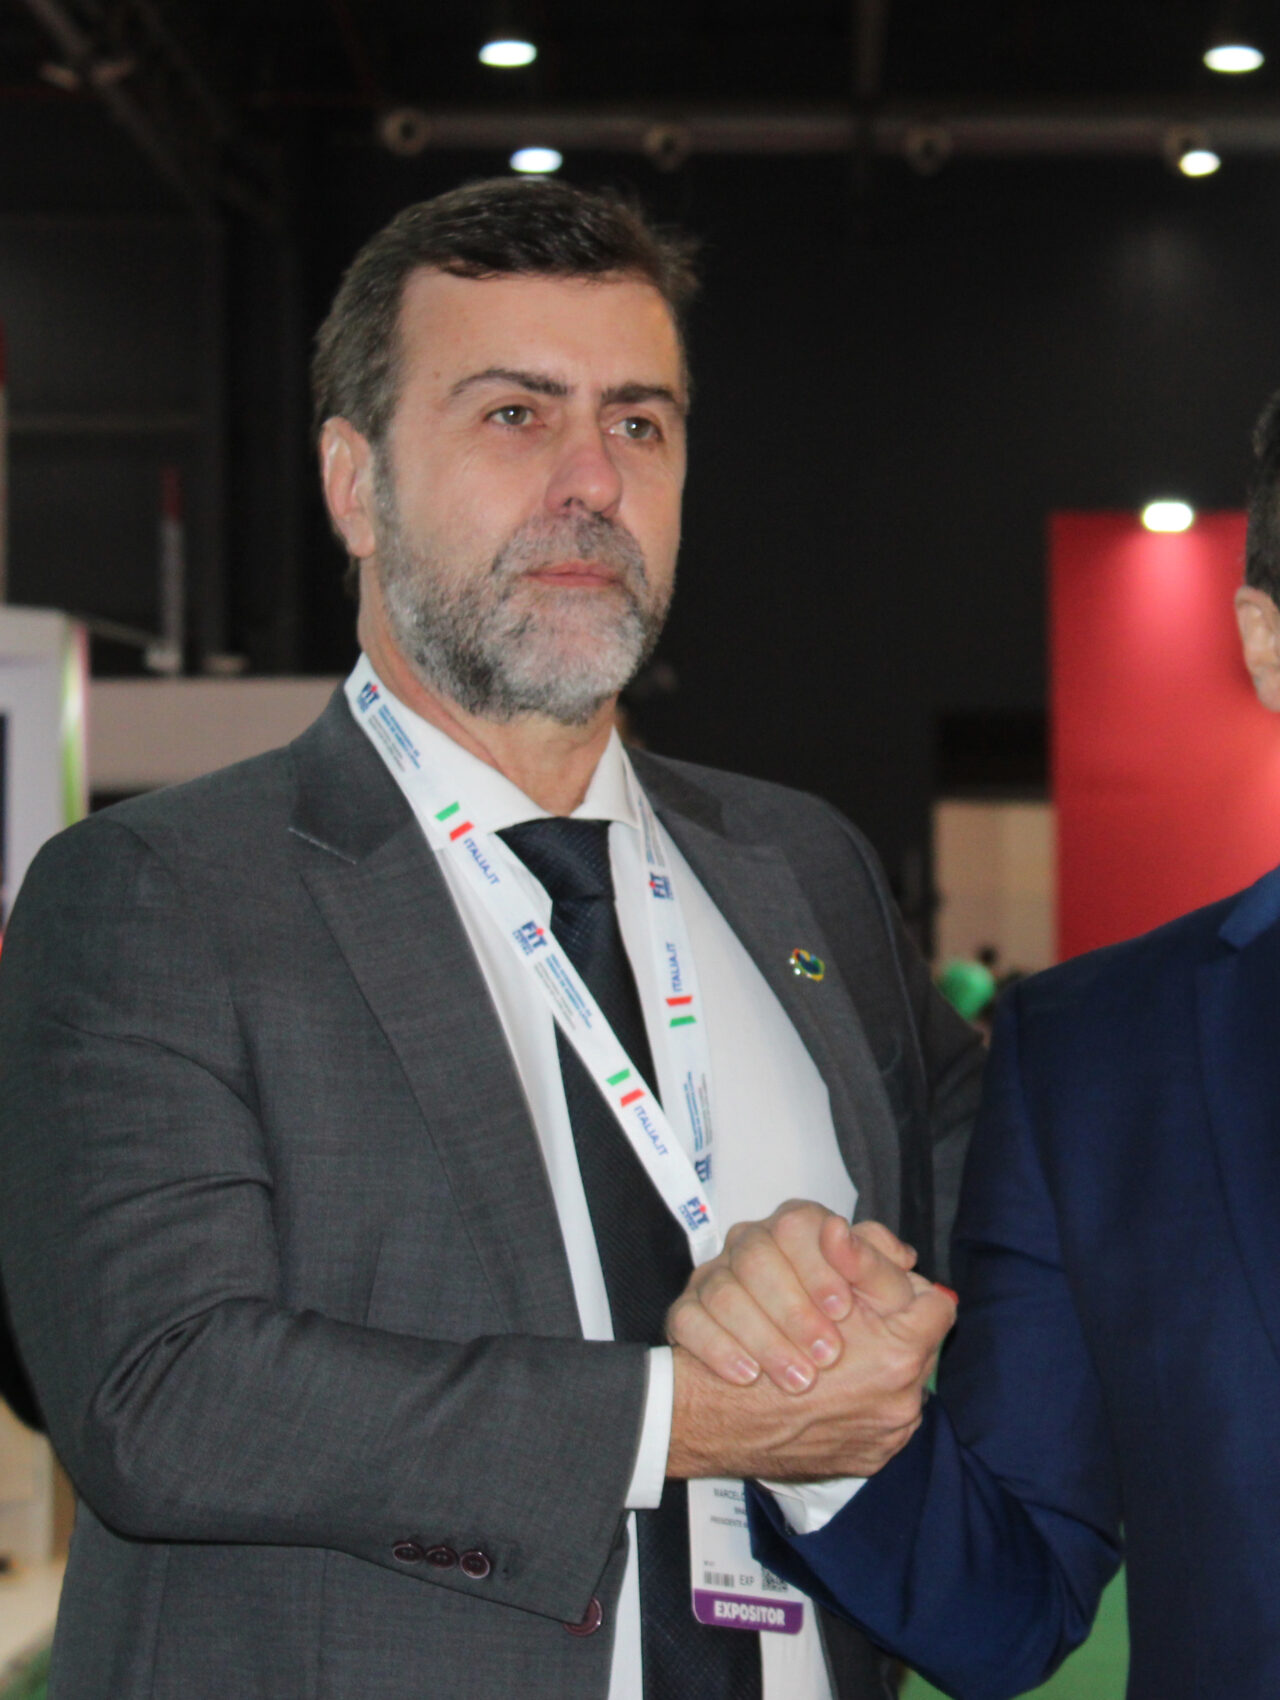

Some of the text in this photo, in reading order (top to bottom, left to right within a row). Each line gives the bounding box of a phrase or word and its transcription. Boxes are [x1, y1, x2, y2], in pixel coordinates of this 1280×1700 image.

[464, 837, 500, 885] ITALIA.IT
[665, 942, 684, 992] ITALIA.IT
[634, 1105, 668, 1157] ITALIA.IT
[739, 1575, 755, 1586] EXP
[713, 1600, 786, 1626] EXPOSITOR
